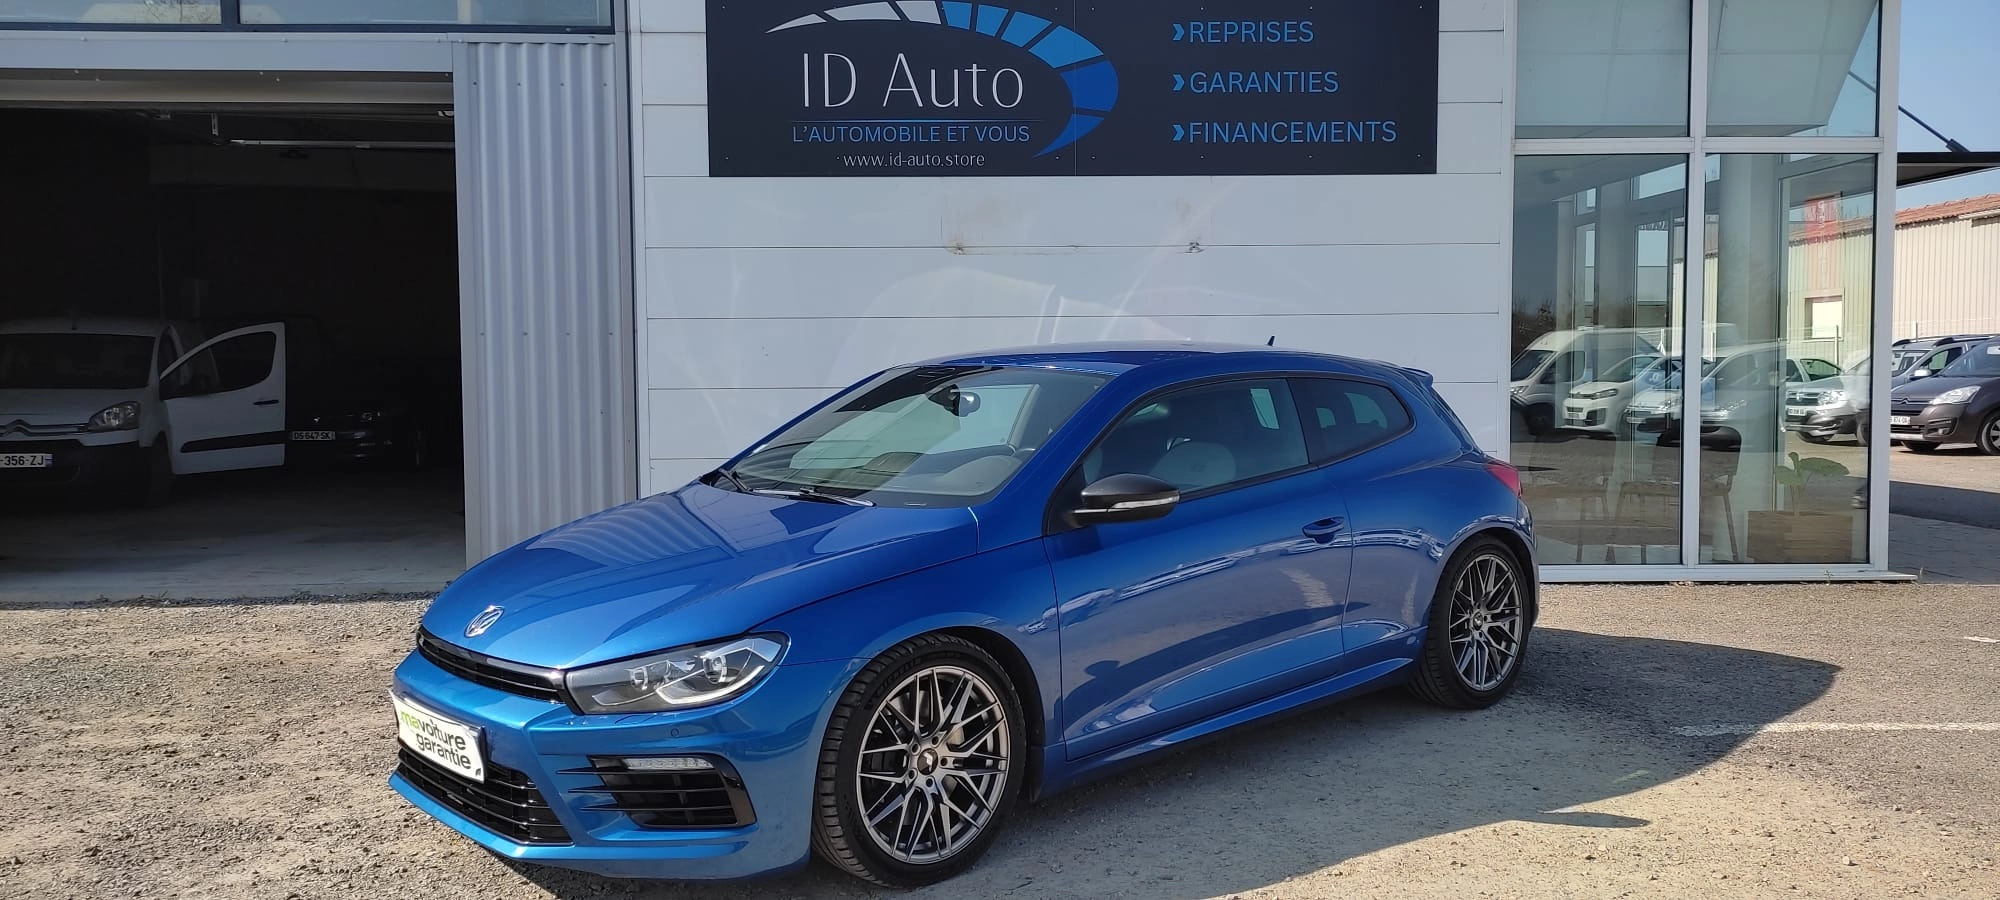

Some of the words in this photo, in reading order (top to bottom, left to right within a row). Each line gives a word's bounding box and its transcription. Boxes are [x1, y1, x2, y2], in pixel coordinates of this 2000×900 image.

[1189, 21, 1314, 43] REPRISES
[803, 52, 857, 108] ID
[882, 52, 1024, 108] Auto
[1189, 71, 1339, 93] GARANTIES
[947, 125, 970, 142] ET
[975, 125, 1031, 142] VOUS
[1189, 121, 1397, 143] FINANCEMENTS
[843, 151, 986, 167] www.id-auto.store
[416, 733, 471, 770] garantie
